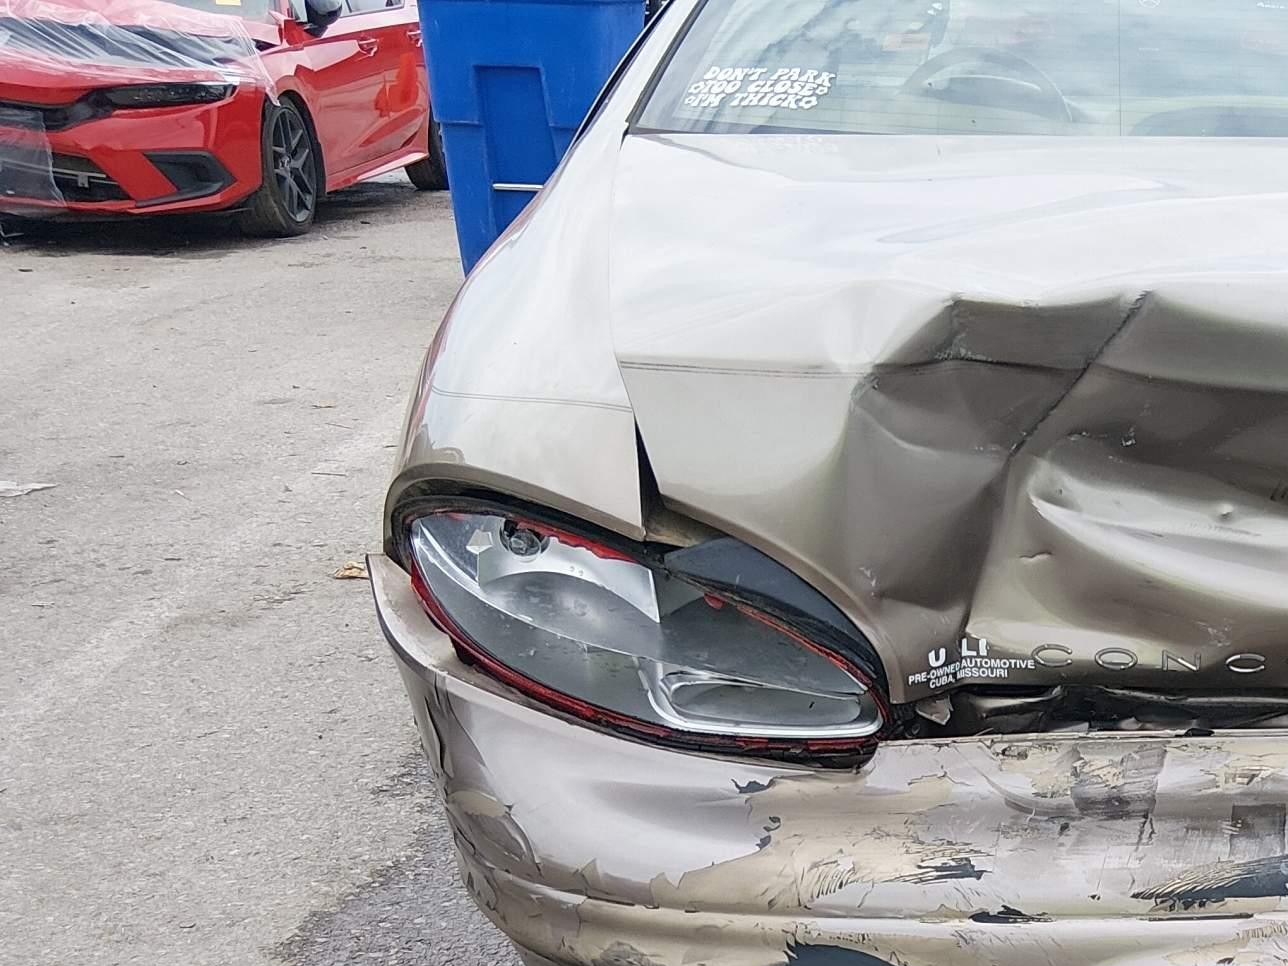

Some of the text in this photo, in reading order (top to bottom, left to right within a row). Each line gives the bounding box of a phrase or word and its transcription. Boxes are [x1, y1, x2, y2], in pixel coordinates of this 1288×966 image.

[704, 66, 836, 87] DON'T PARK
[700, 80, 818, 96] TOO CLOSE
[729, 93, 802, 109] THICK
[908, 658, 1036, 686] PRE-OWNED AUTOMOTIVE
[929, 667, 1008, 689] CUBA, MISSOURI
